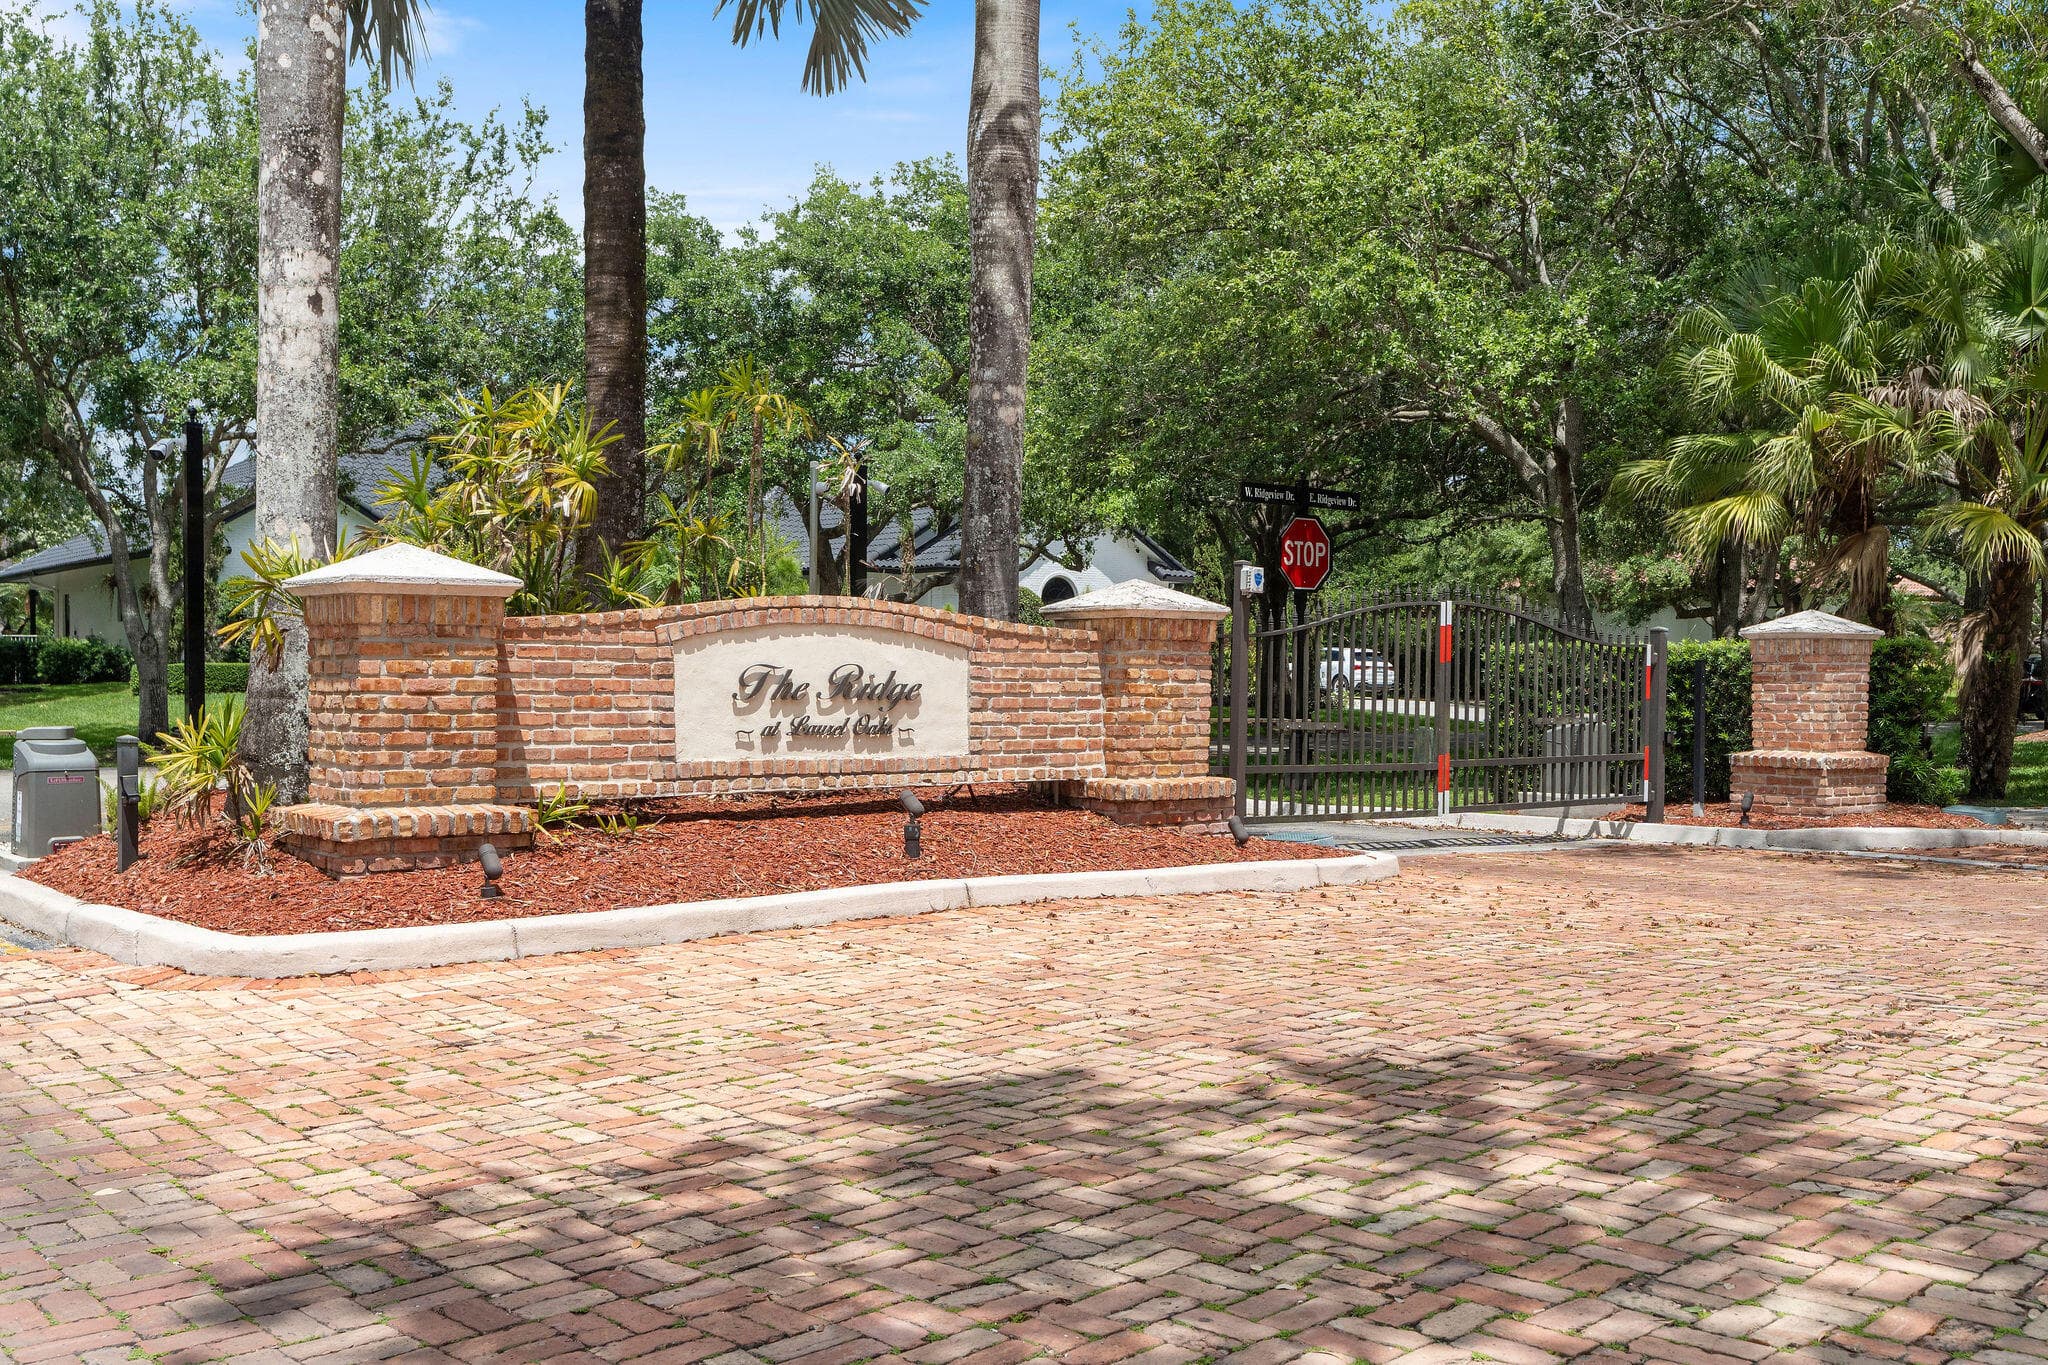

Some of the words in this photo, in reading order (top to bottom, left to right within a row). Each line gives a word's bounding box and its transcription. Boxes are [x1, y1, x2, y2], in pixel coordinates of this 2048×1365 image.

[1244, 486, 1253, 498] W.
[1254, 487, 1284, 502] Ridgeview
[1285, 490, 1296, 501] Dr.
[1309, 492, 1316, 503] E.
[1317, 493, 1347, 507] Ridgeview
[1348, 496, 1358, 507] Dr.
[1283, 540, 1326, 567] STOP
[732, 663, 810, 701] The
[816, 663, 923, 712] Ridge
[760, 721, 782, 737] at
[786, 715, 850, 737] Laurel
[852, 714, 893, 736] Oaks
